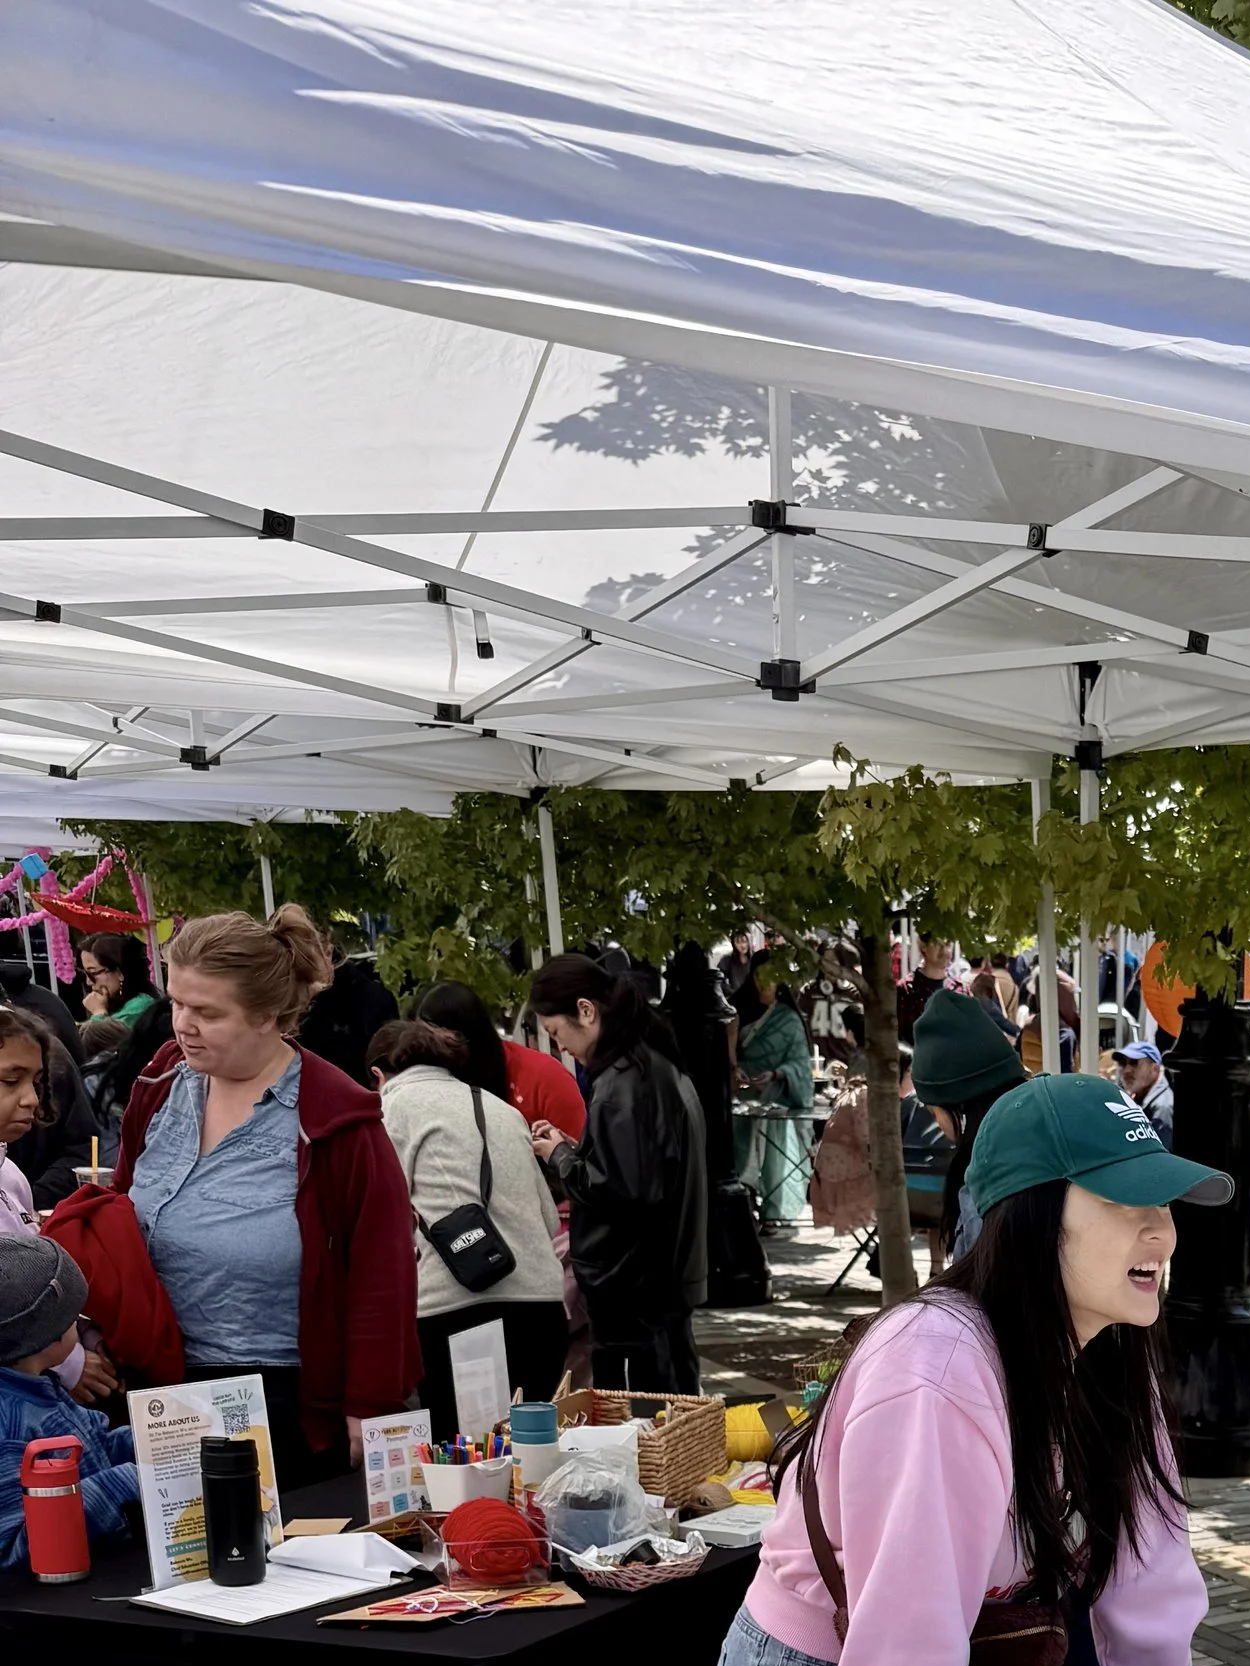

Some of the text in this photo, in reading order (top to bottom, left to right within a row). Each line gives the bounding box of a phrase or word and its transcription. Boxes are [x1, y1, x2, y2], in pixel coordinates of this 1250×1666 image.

[148, 1415, 201, 1430] MORE ABOUT US
